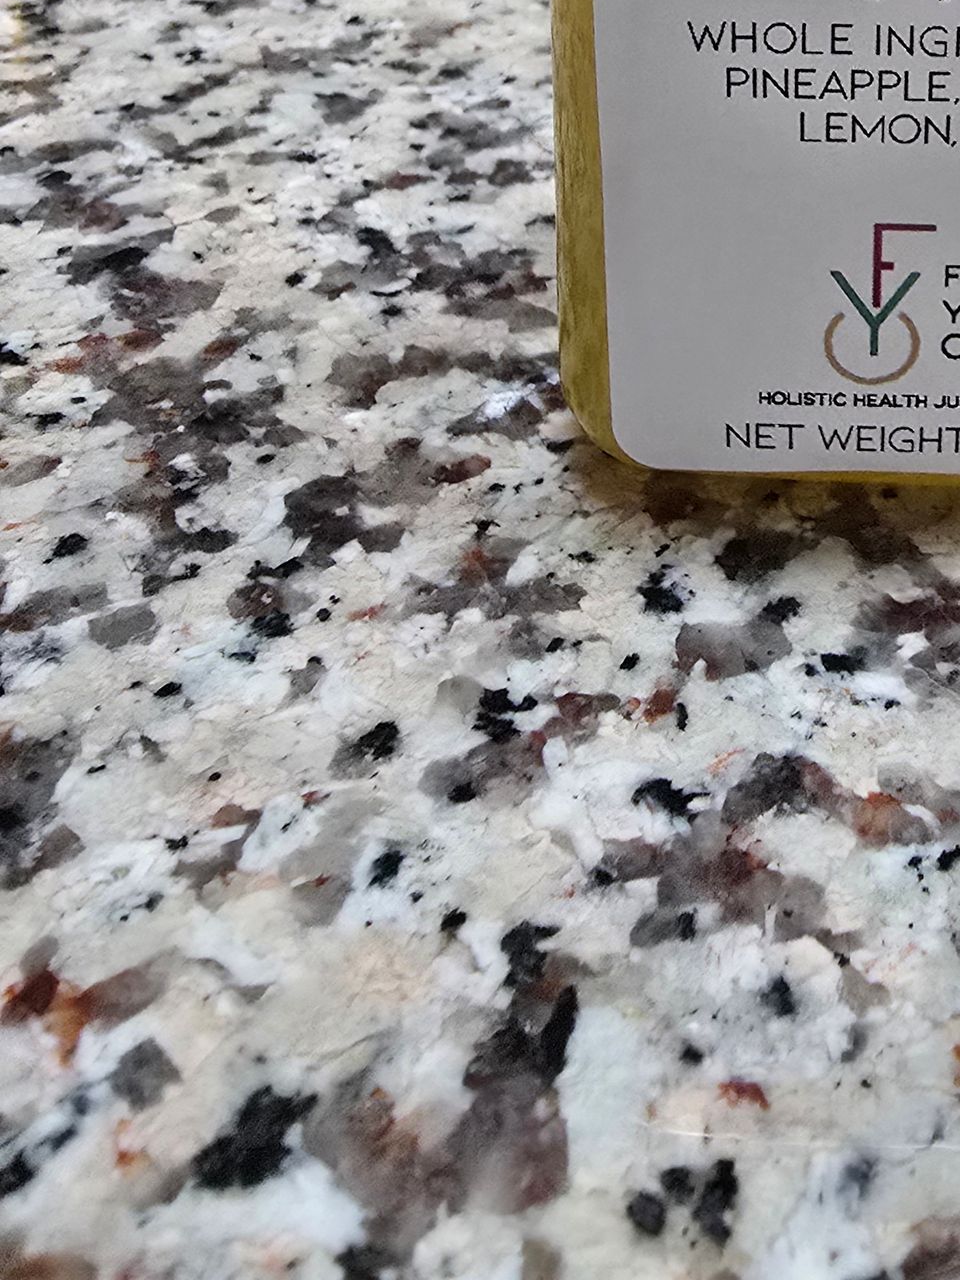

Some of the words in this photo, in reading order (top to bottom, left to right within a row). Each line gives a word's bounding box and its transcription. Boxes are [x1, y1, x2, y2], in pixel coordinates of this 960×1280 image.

[687, 21, 853, 56] WHOLE
[800, 113, 957, 148] LEMON,
[758, 391, 847, 407] HOLISTIC
[853, 392, 928, 409] HEALTH
[725, 423, 805, 450] NET
